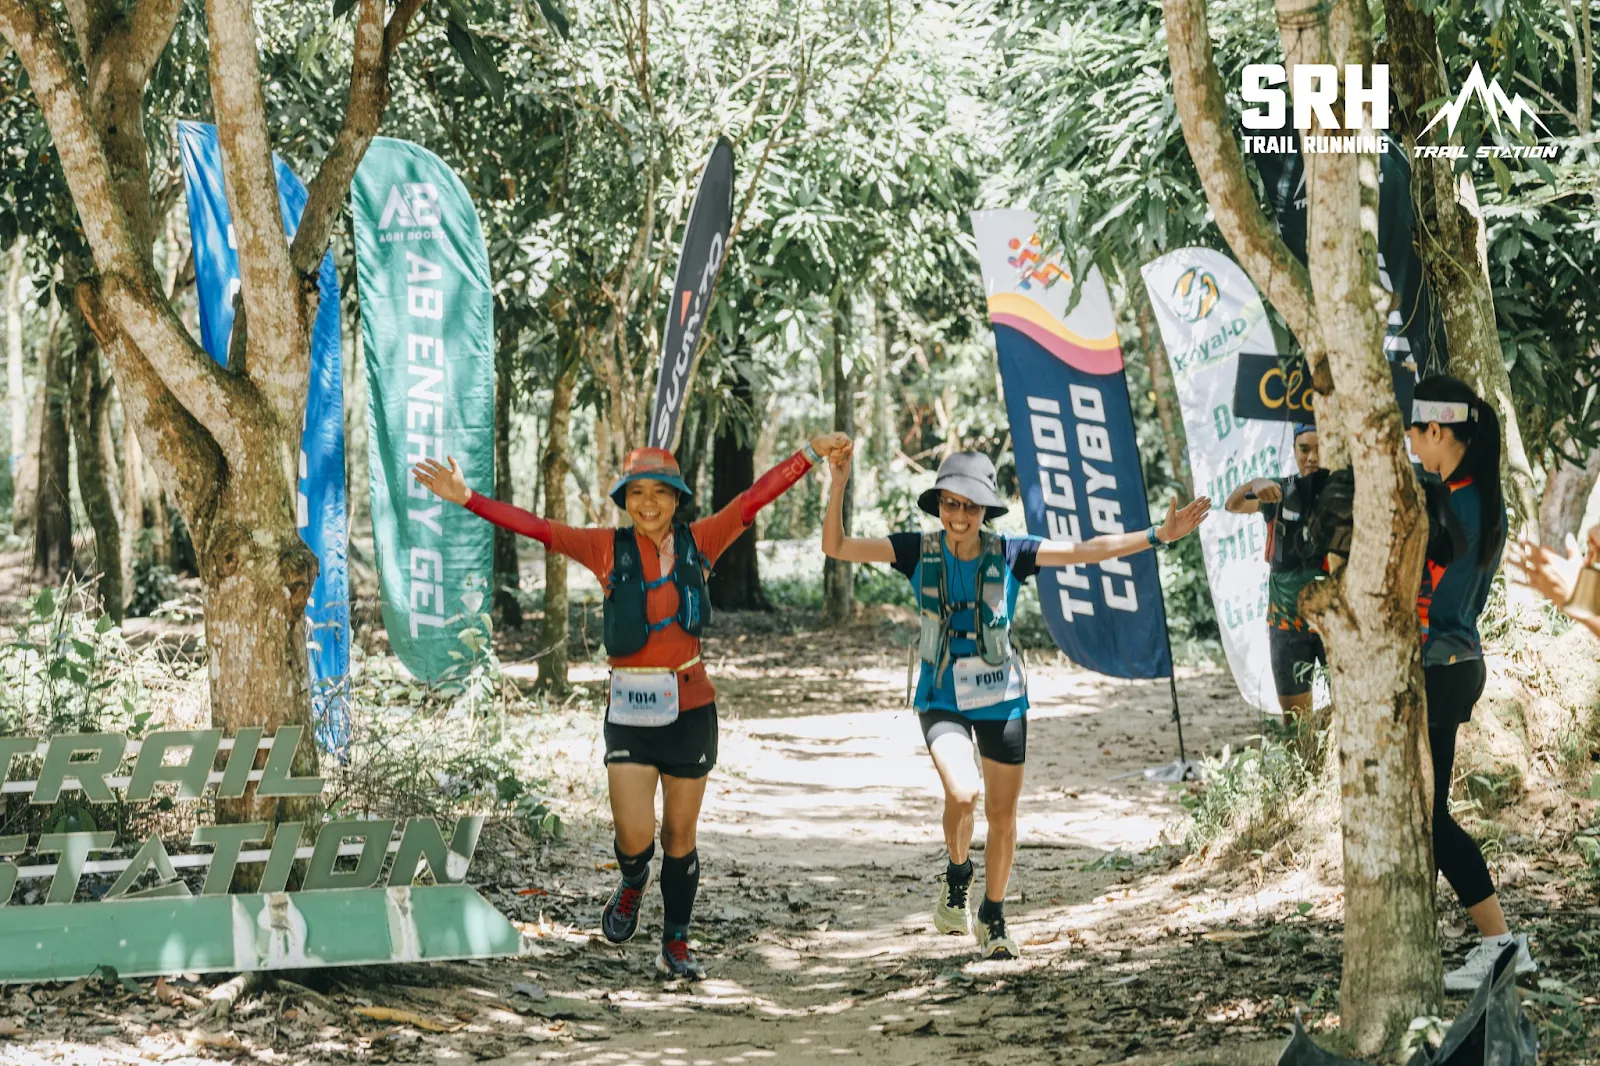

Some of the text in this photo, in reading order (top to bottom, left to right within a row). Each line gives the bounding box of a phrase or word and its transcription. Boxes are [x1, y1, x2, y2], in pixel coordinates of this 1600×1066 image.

[379, 232, 404, 243] AGRI
[406, 251, 443, 320] AB
[409, 547, 446, 638] GEL
[628, 691, 657, 705] F014
[975, 669, 1004, 686] F010
[0, 725, 325, 804] TRAIL
